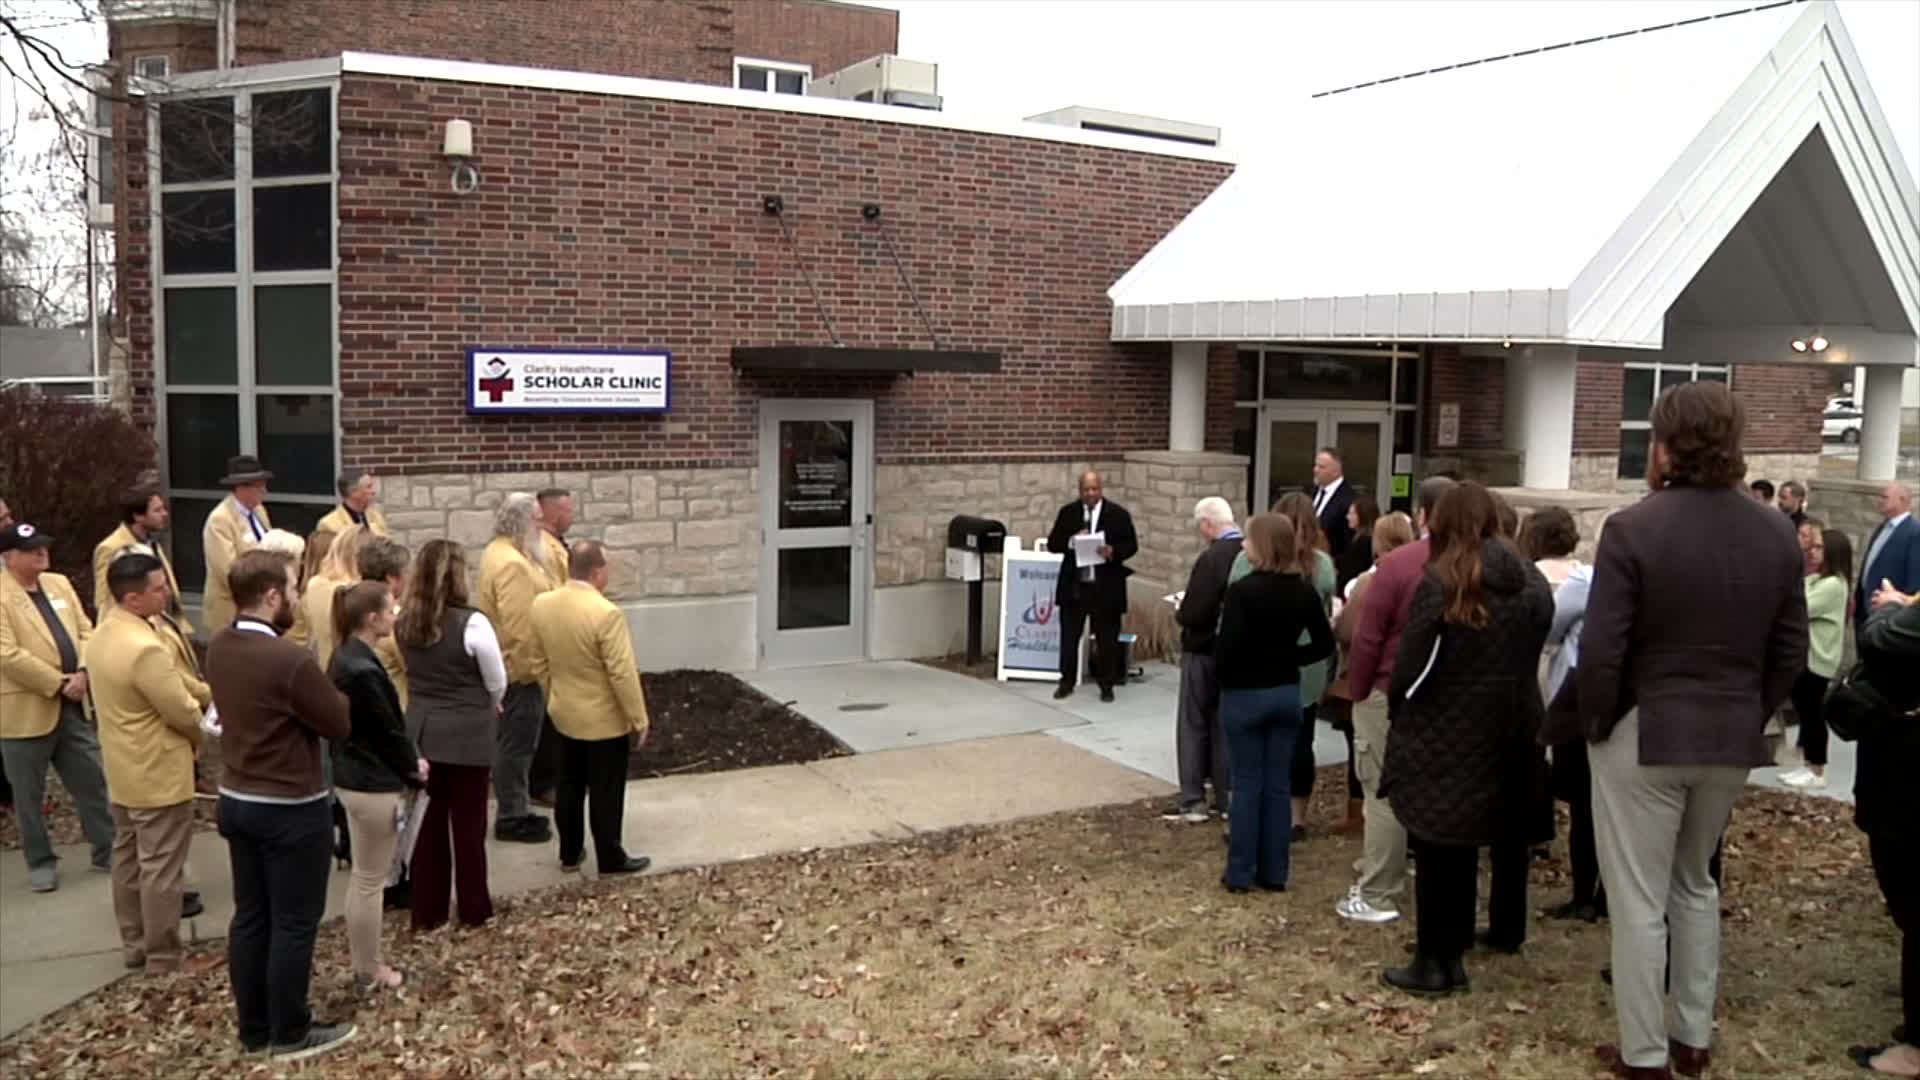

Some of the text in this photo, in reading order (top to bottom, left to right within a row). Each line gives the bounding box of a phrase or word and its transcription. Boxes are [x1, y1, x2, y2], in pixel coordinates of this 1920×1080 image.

[523, 364, 614, 375] Clarity Healthcare
[524, 376, 661, 389] SCHOLAR CLINIC
